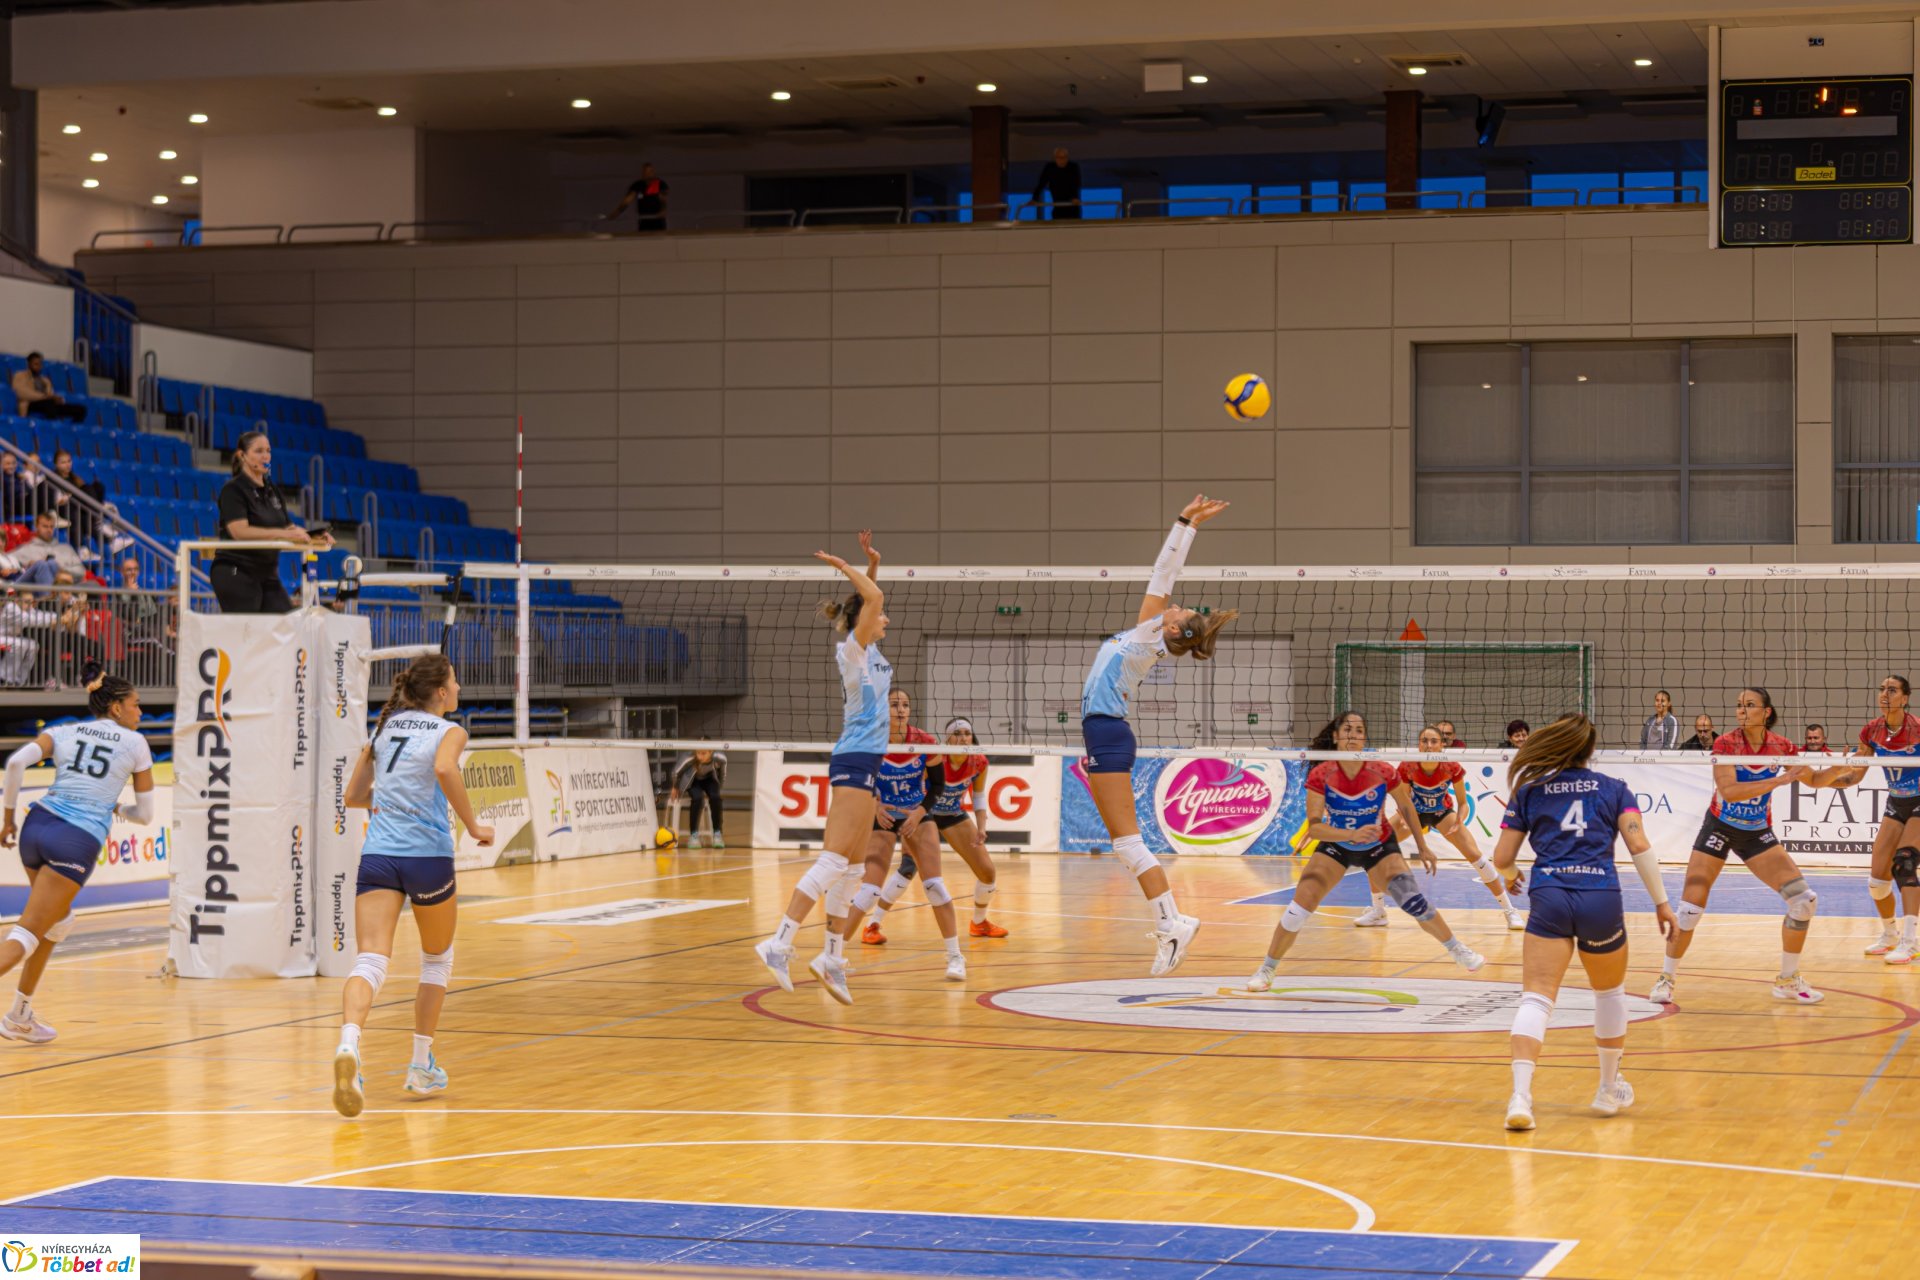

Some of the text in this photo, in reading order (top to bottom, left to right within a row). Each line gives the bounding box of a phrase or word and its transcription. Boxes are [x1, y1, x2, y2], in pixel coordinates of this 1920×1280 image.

[1799, 170, 1833, 179] Bodet
[336, 640, 349, 719] TippmixPRO
[293, 648, 307, 770] TippmixPRO
[76, 726, 121, 742] MURILLO
[67, 740, 113, 779] 15
[386, 736, 410, 773] 7
[458, 762, 516, 789] udatosan
[570, 768, 630, 791] NYÍREGYHÁZI
[1544, 779, 1600, 795] KERTÉSZ
[1887, 767, 1903, 782] 17
[190, 648, 239, 944] TippmixPRO
[334, 756, 347, 835] TippmixPRO
[891, 781, 911, 796] 14
[575, 795, 646, 818] SPORTCENTRUM
[1163, 775, 1271, 834] Aquarius
[1202, 805, 1267, 814] NYÍREGYHÁZA
[1423, 797, 1437, 808] 10
[1345, 817, 1357, 830] 2
[1560, 800, 1588, 837] 4
[1705, 834, 1725, 851] 23
[290, 824, 305, 946] TippmixPRO
[331, 873, 345, 952] TippmixPRO
